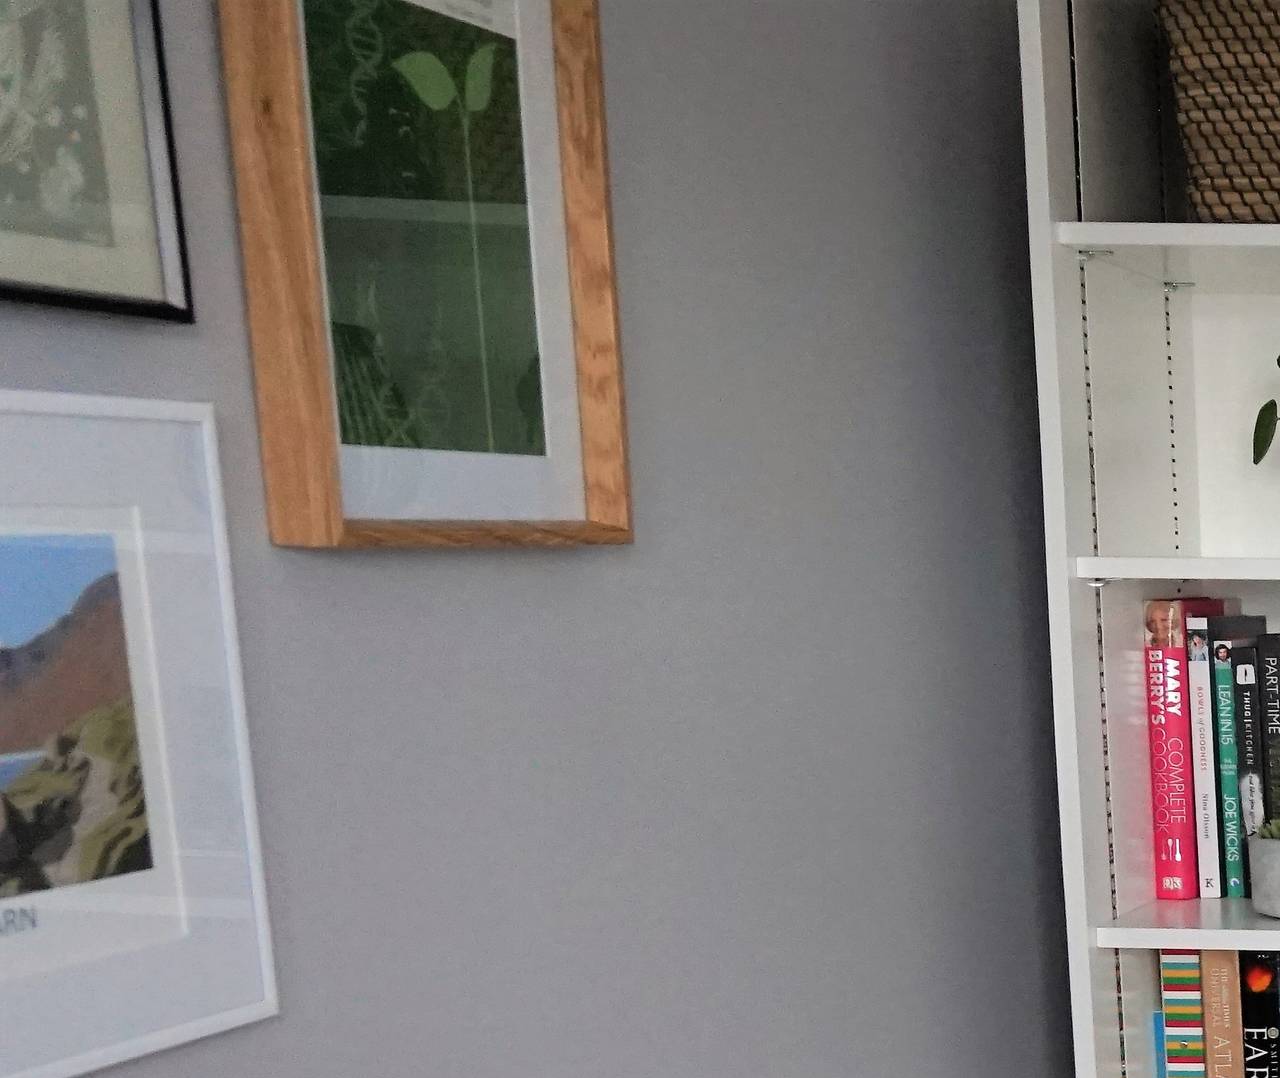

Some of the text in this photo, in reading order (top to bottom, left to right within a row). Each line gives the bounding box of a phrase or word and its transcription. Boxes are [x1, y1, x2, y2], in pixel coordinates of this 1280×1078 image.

[1149, 649, 1165, 725] BERRY'S
[1166, 658, 1182, 717] MARY
[1218, 684, 1232, 716] LEAN
[1243, 691, 1252, 717] THUG
[1264, 656, 1280, 734] PART-TIME
[1152, 726, 1168, 834] COOKBOOK
[1167, 737, 1186, 824] COMPLETE
[1224, 793, 1239, 861] JOE WICKS
